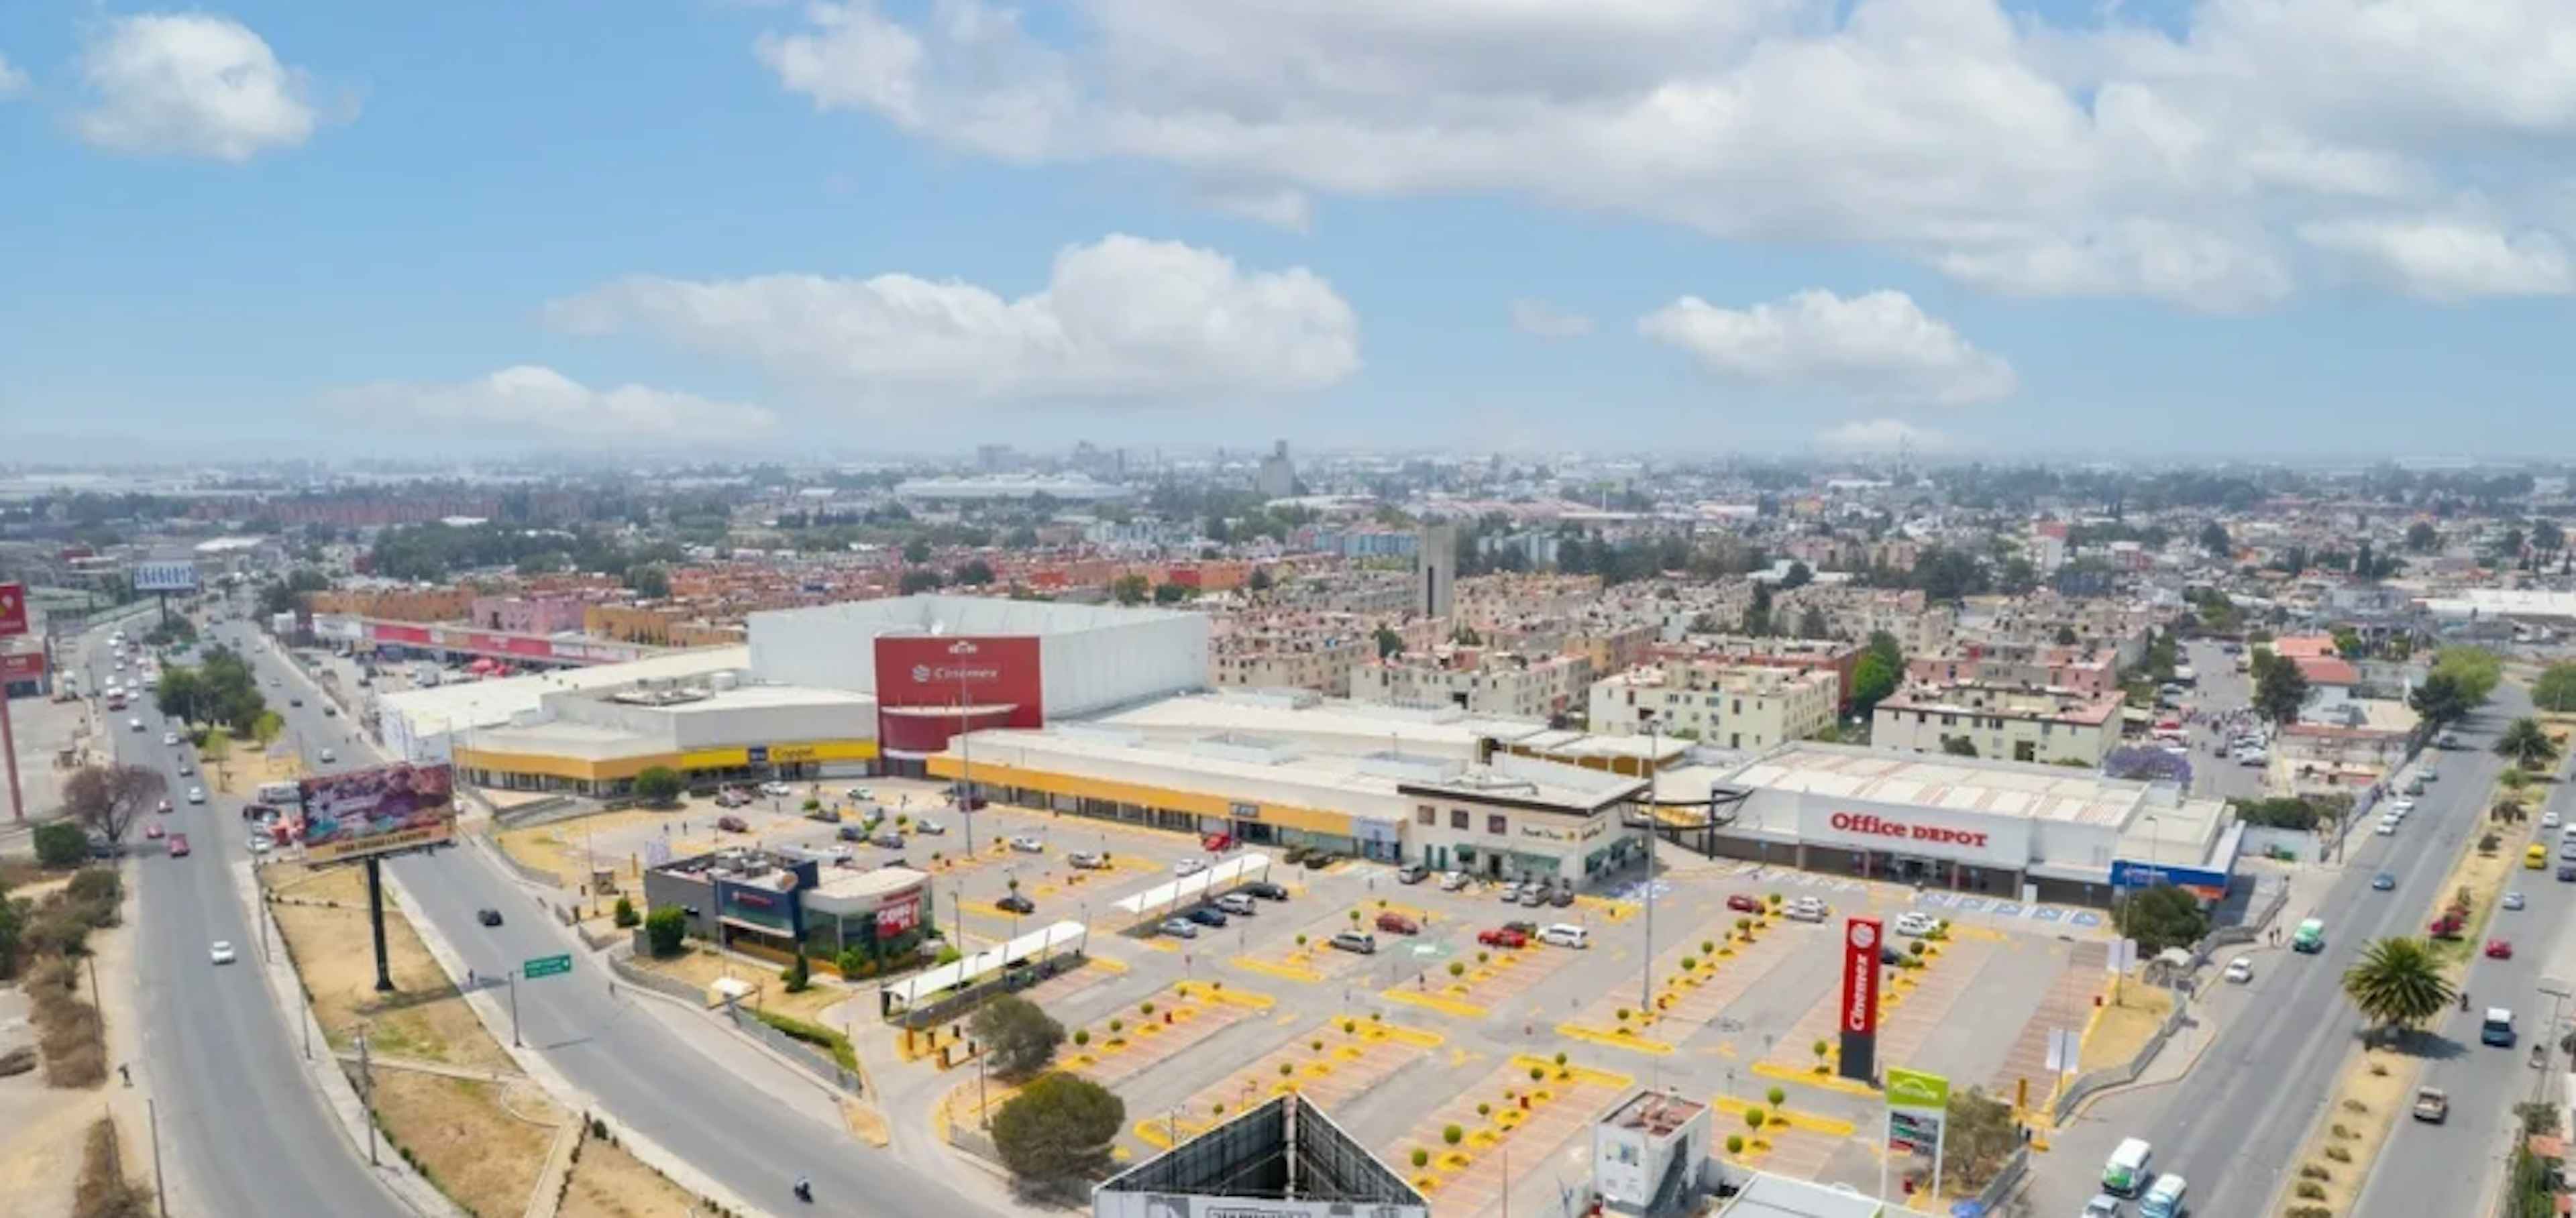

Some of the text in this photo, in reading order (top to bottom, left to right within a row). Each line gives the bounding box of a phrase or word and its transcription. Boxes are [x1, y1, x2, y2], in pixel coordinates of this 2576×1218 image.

[1831, 812, 1988, 847] Office DEPOT
[1849, 952, 1868, 1031] Cinemex
